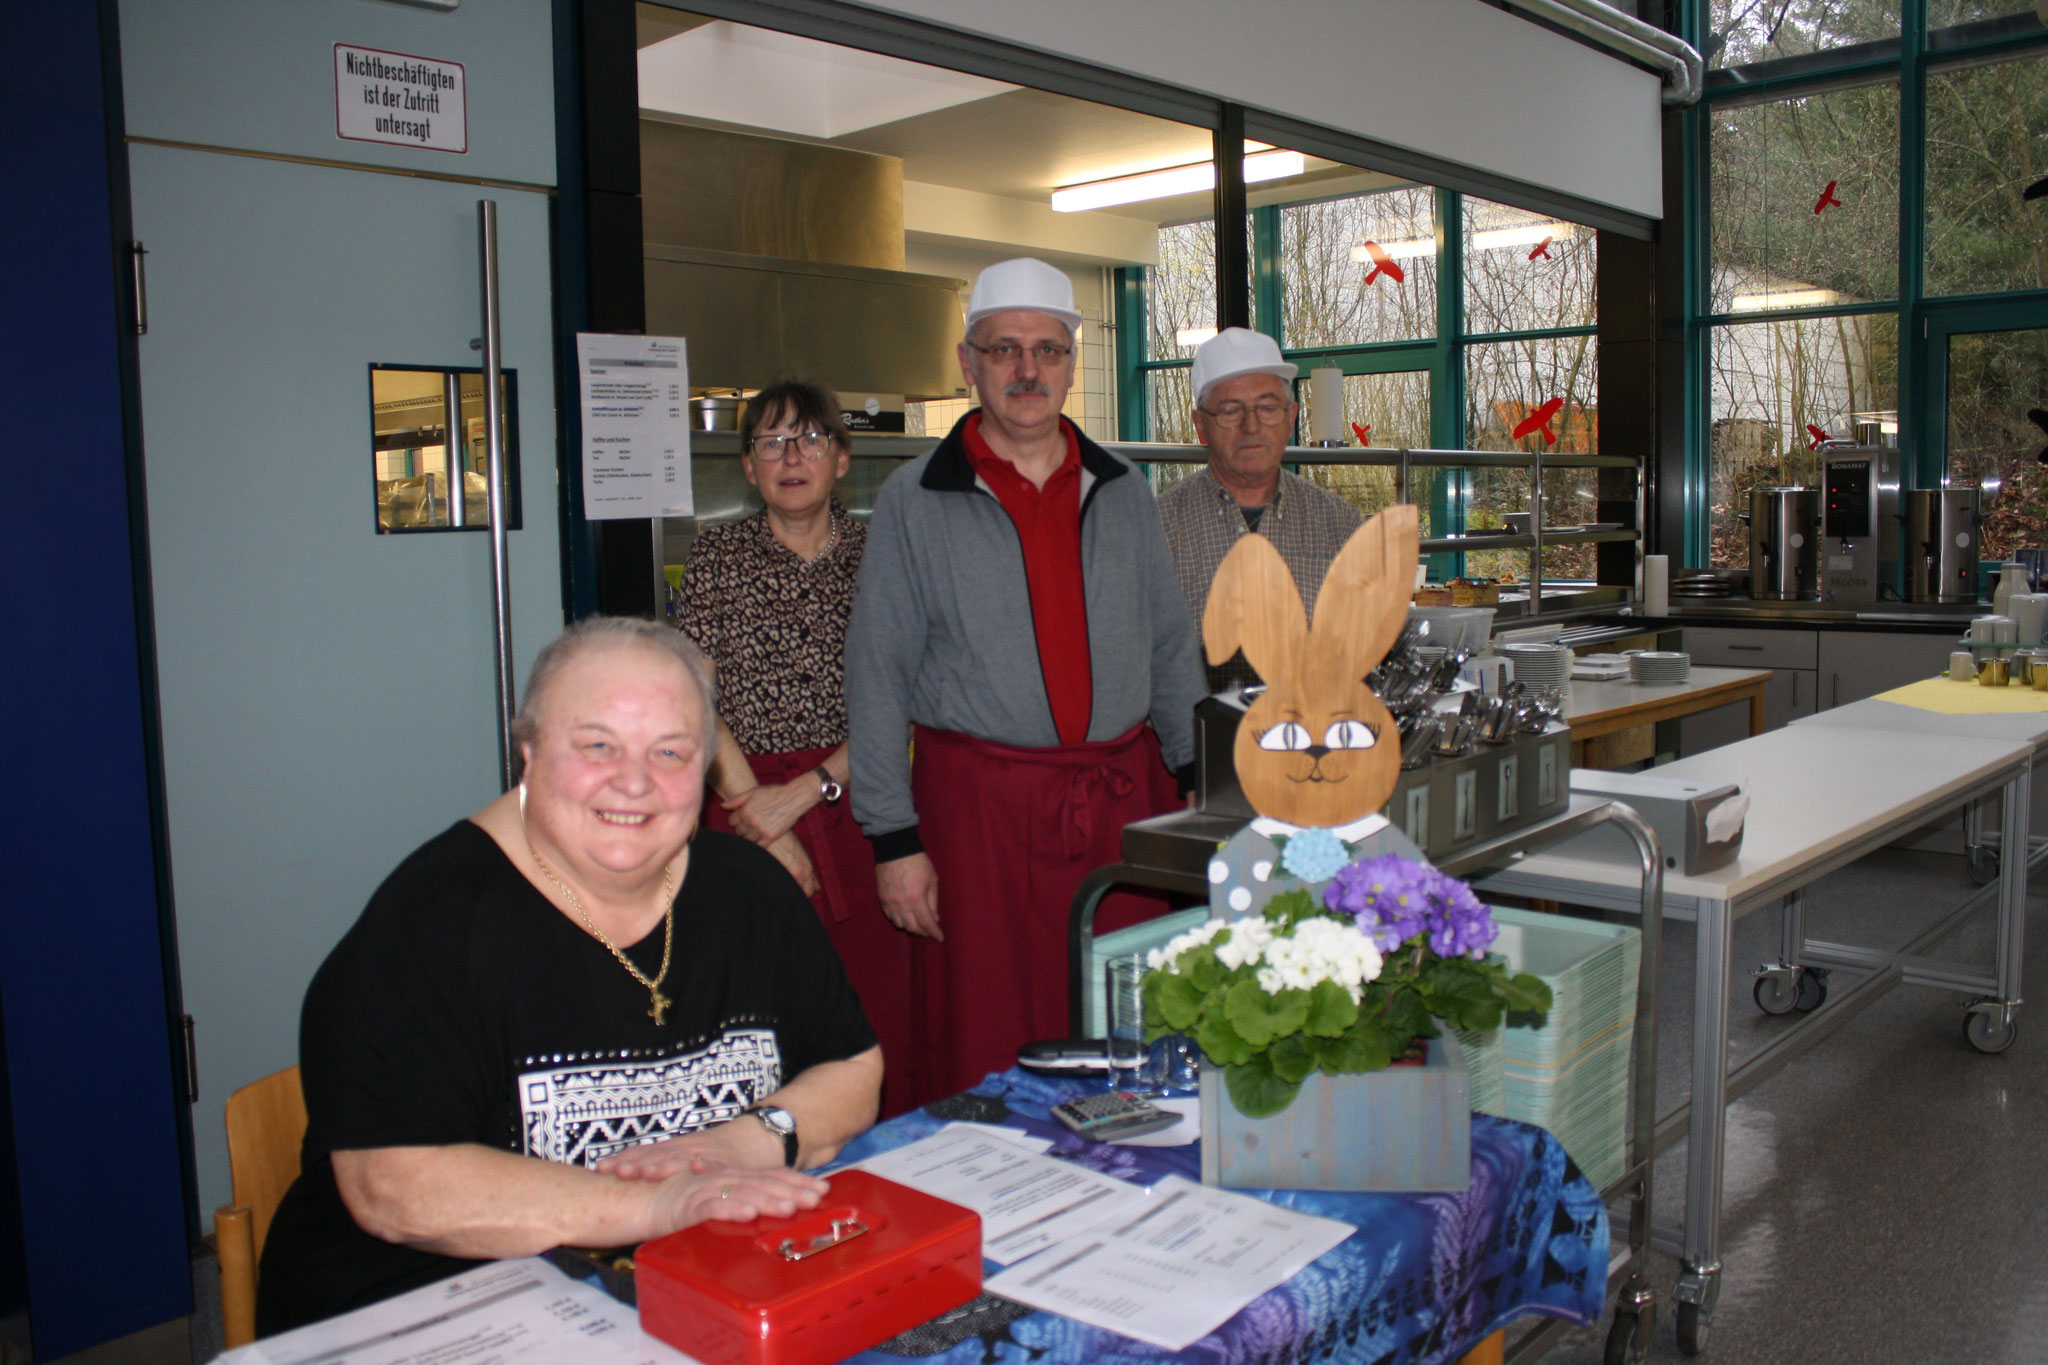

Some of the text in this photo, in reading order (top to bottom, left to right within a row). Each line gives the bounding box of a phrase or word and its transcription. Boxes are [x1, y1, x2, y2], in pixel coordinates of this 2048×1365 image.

[346, 51, 455, 91] Nichtbeschäftigten
[364, 84, 440, 114] ist der Zutritt
[375, 112, 431, 142] untersagt
